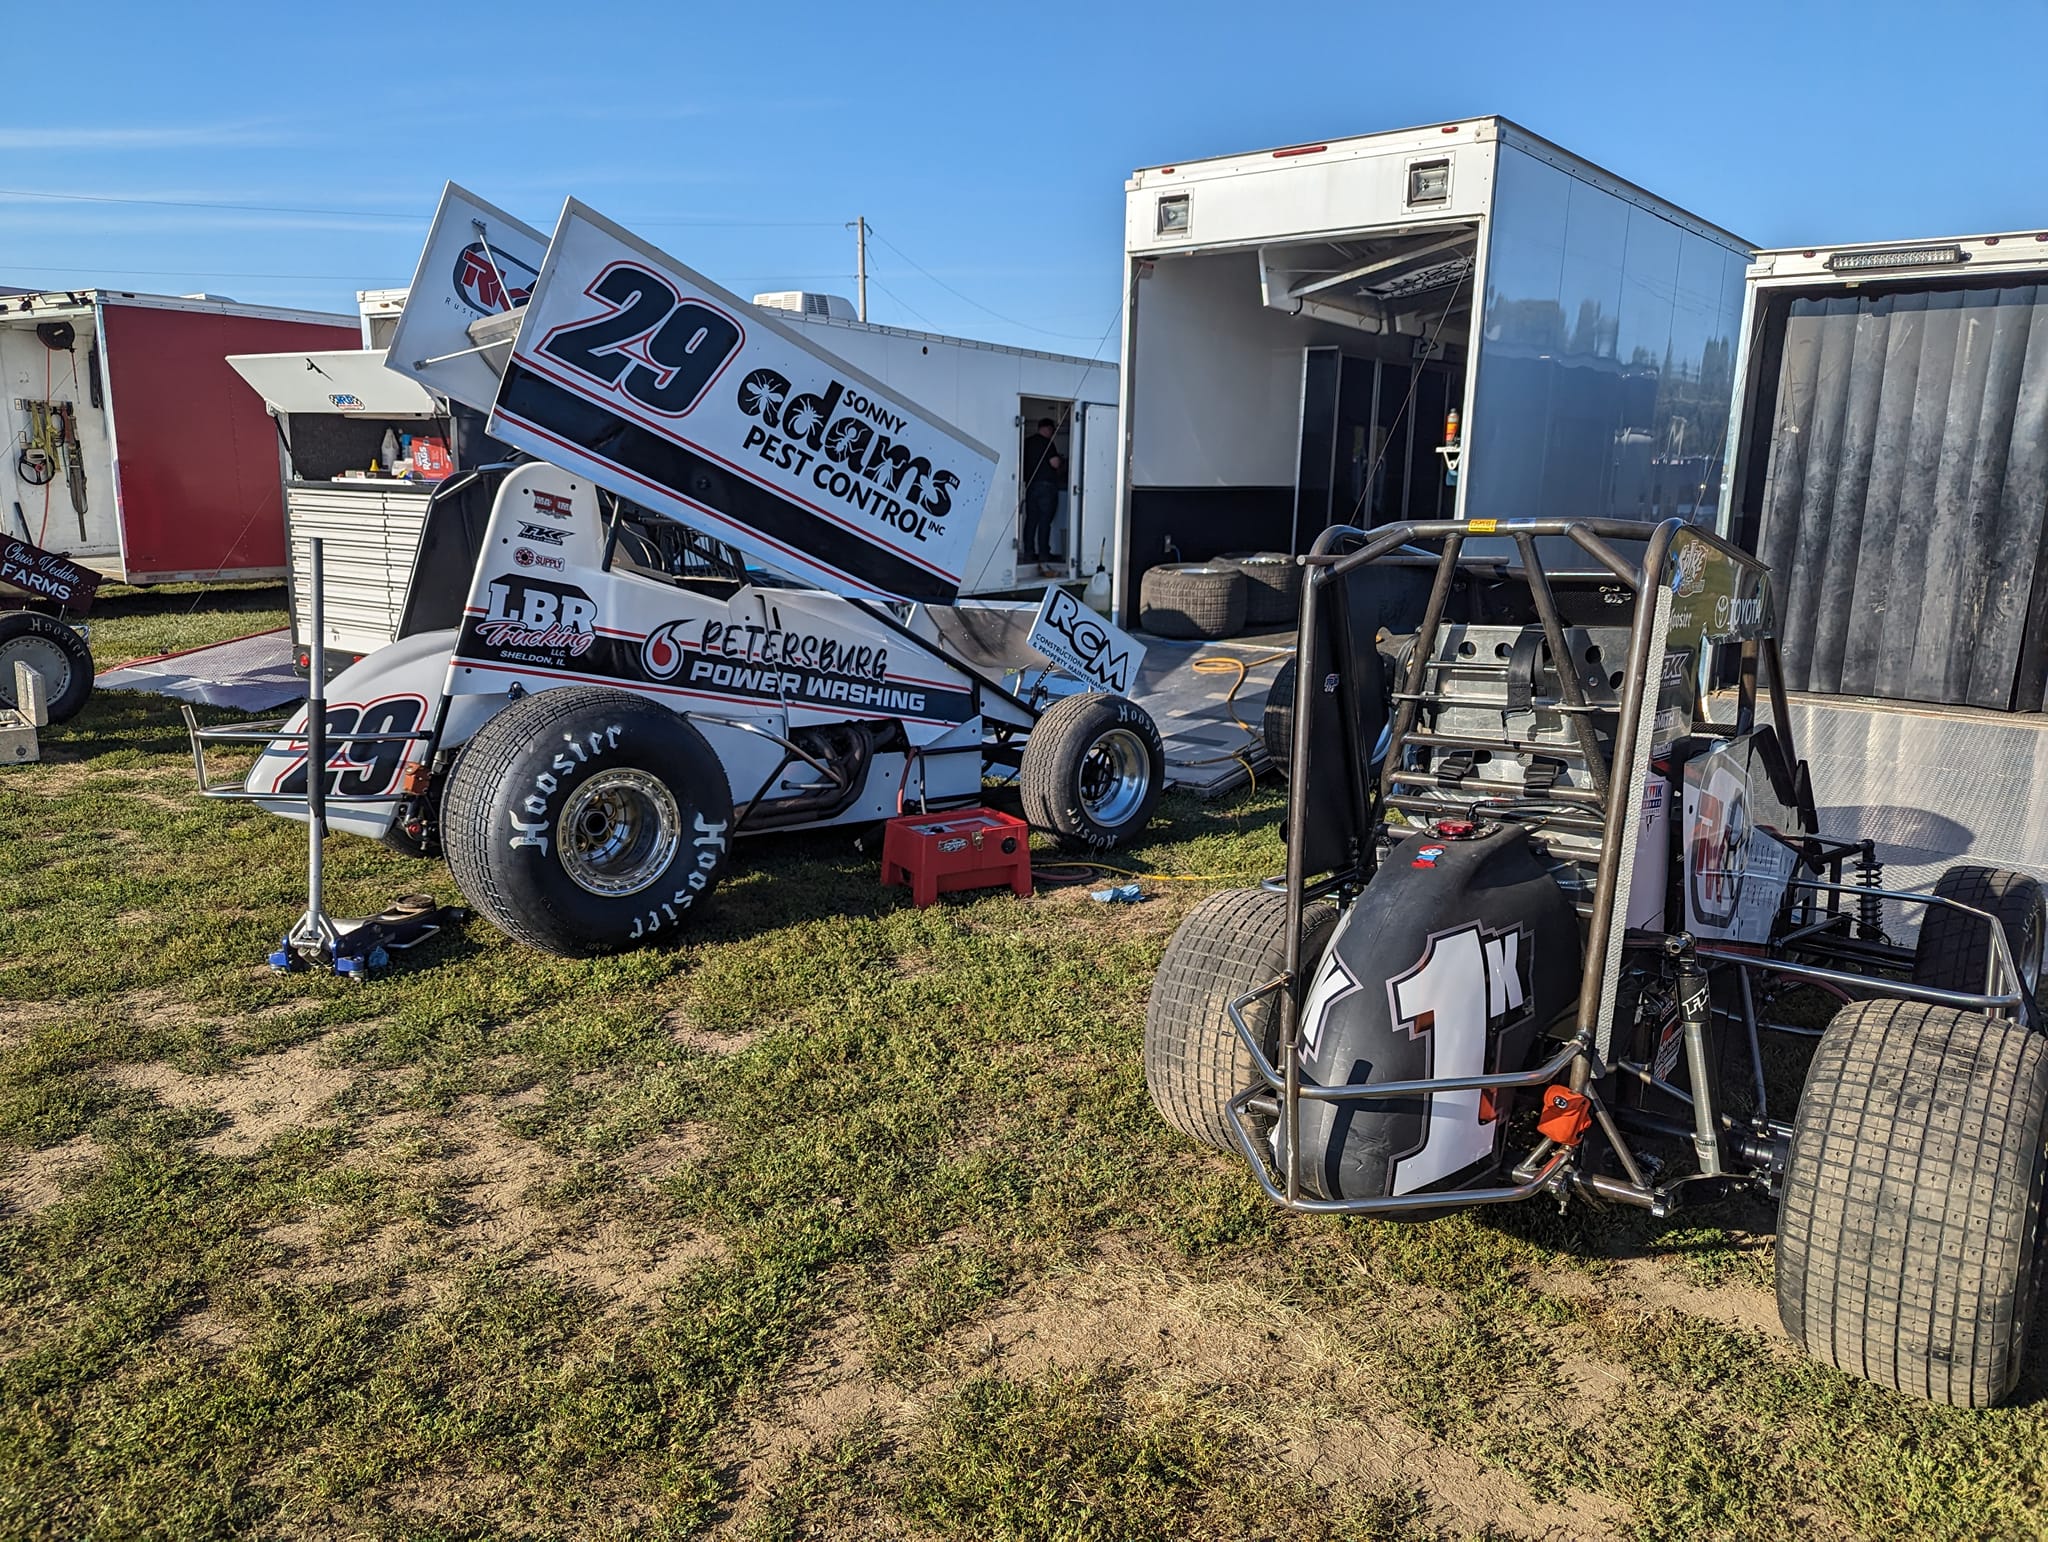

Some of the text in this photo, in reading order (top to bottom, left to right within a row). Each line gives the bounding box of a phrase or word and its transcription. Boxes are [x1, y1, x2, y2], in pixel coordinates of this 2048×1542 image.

[536, 262, 744, 416] 29
[842, 389, 907, 435] SONNY
[742, 425, 946, 543] PEST CONTROL INC
[0, 562, 72, 601] FARMS
[4, 541, 81, 585] Chris Vedder
[535, 555, 563, 570] SUPPLY
[485, 581, 598, 635] LBR
[1730, 597, 1762, 630] TOYOTA
[28, 617, 87, 659] Hoosier
[475, 621, 596, 657] Trucking
[500, 650, 566, 667] SHELDON, IL
[700, 619, 888, 683] PETERSBURG
[1035, 633, 1084, 669] CONSTRUCTION
[1044, 589, 1129, 693] RCM
[690, 660, 926, 713] POWER WASHING
[1038, 644, 1068, 668] PROPERTY
[1067, 663, 1111, 694] MAINTENANCE
[273, 693, 428, 797] 29
[508, 725, 623, 858] Hoosier
[629, 812, 728, 940] Hoosier
